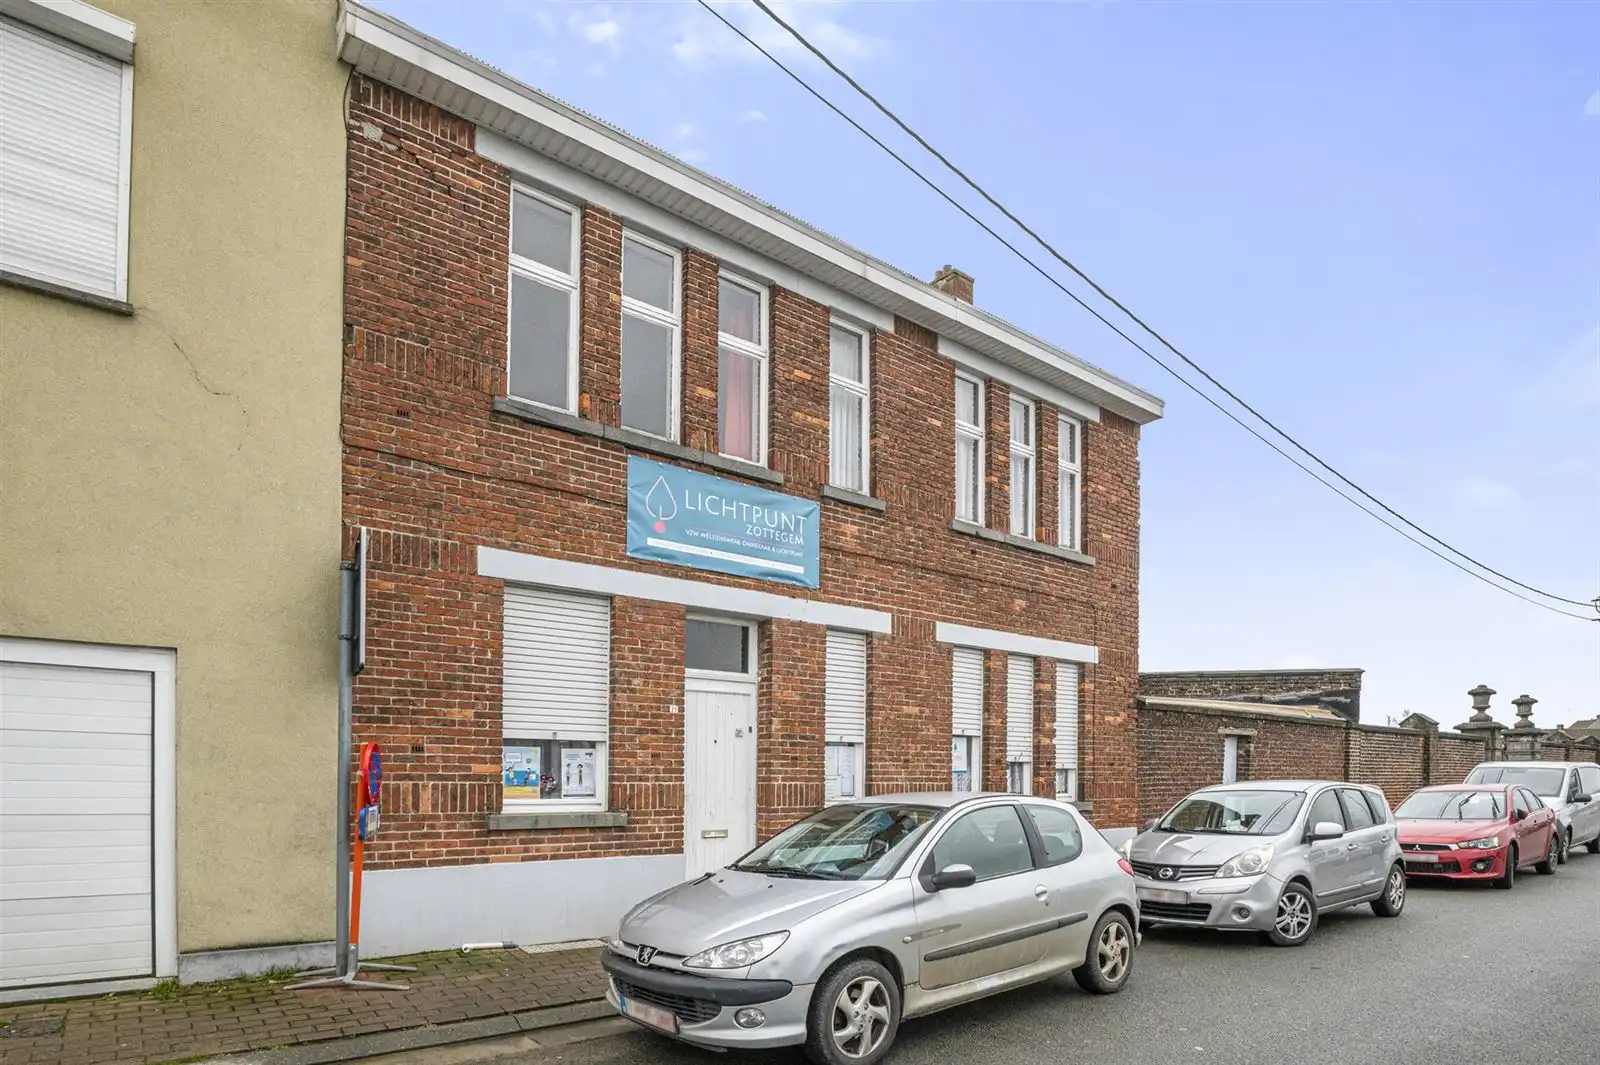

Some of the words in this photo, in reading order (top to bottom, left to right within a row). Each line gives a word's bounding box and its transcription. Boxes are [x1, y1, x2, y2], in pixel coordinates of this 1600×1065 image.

[685, 489, 807, 534] LICHTPUNT
[685, 528, 699, 537] VZW
[746, 524, 804, 546] ZOTTEGEM
